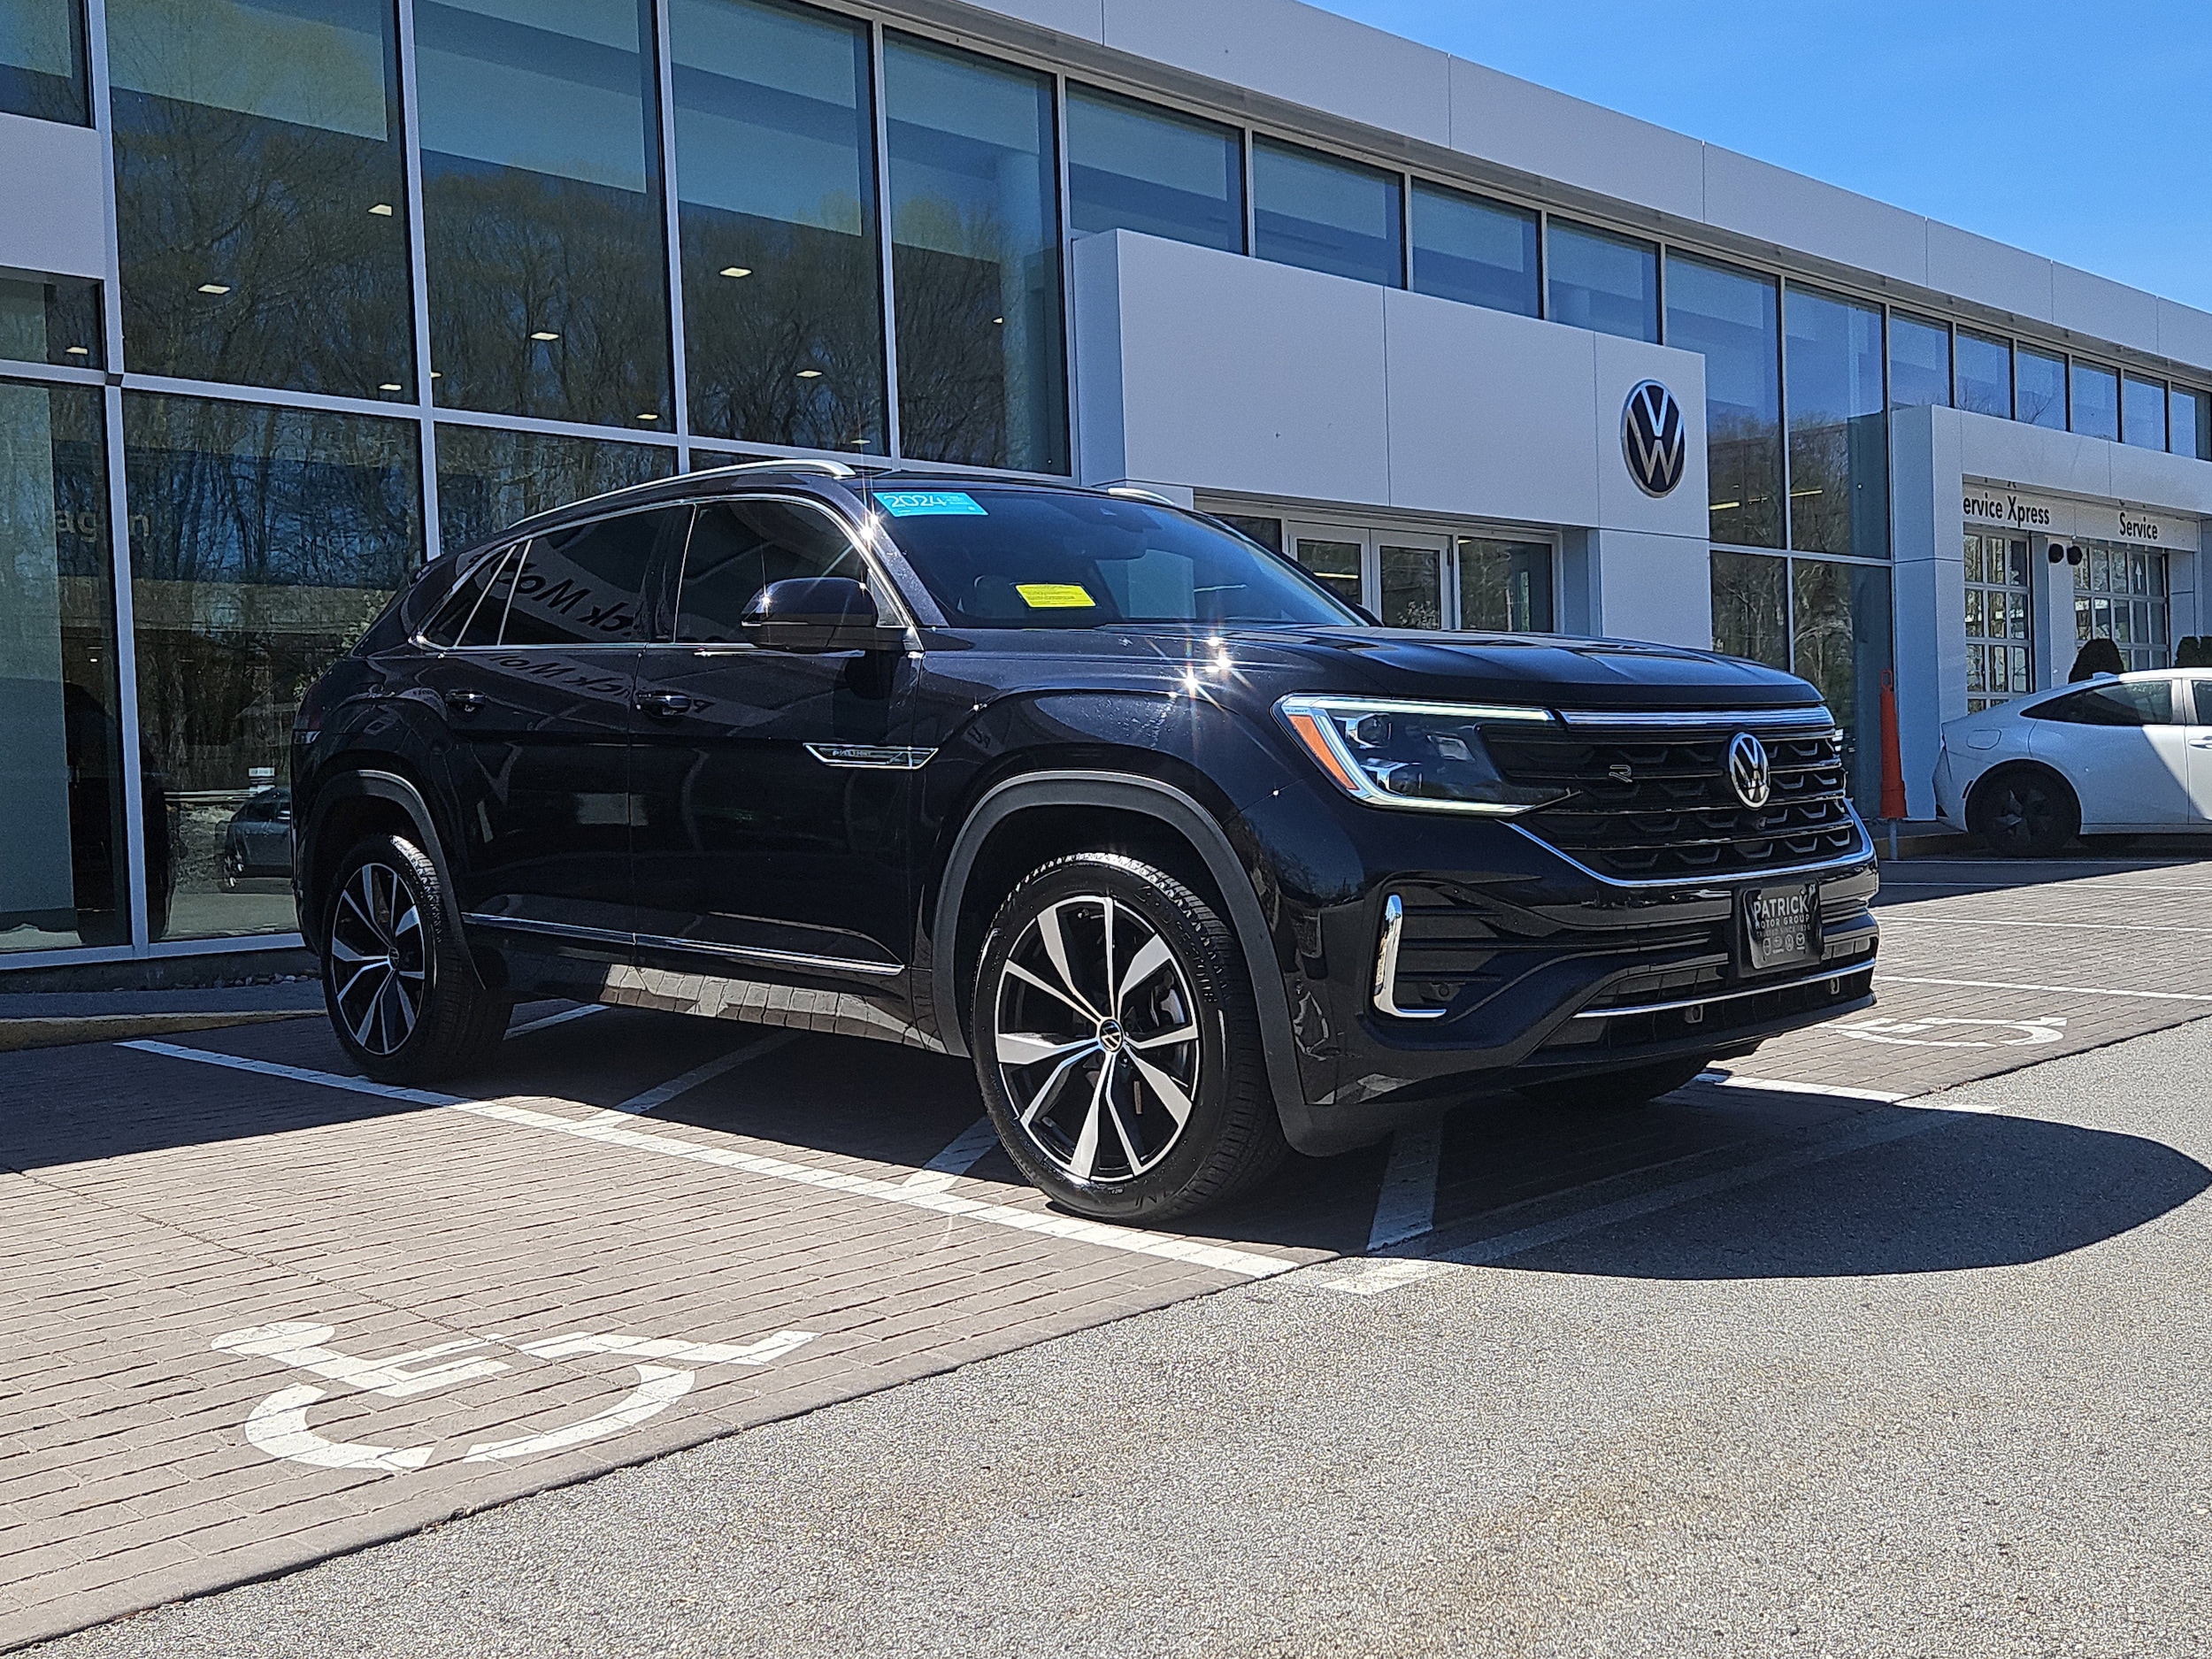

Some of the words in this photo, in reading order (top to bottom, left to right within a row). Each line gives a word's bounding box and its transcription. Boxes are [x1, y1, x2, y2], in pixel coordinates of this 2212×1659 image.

[883, 494, 947, 508] 2024
[1963, 492, 2003, 519] ervice
[2007, 495, 2050, 527] Xpress
[2119, 511, 2159, 541] Service
[1753, 895, 1809, 919] PATRICK
[1783, 914, 1810, 926] GROUP
